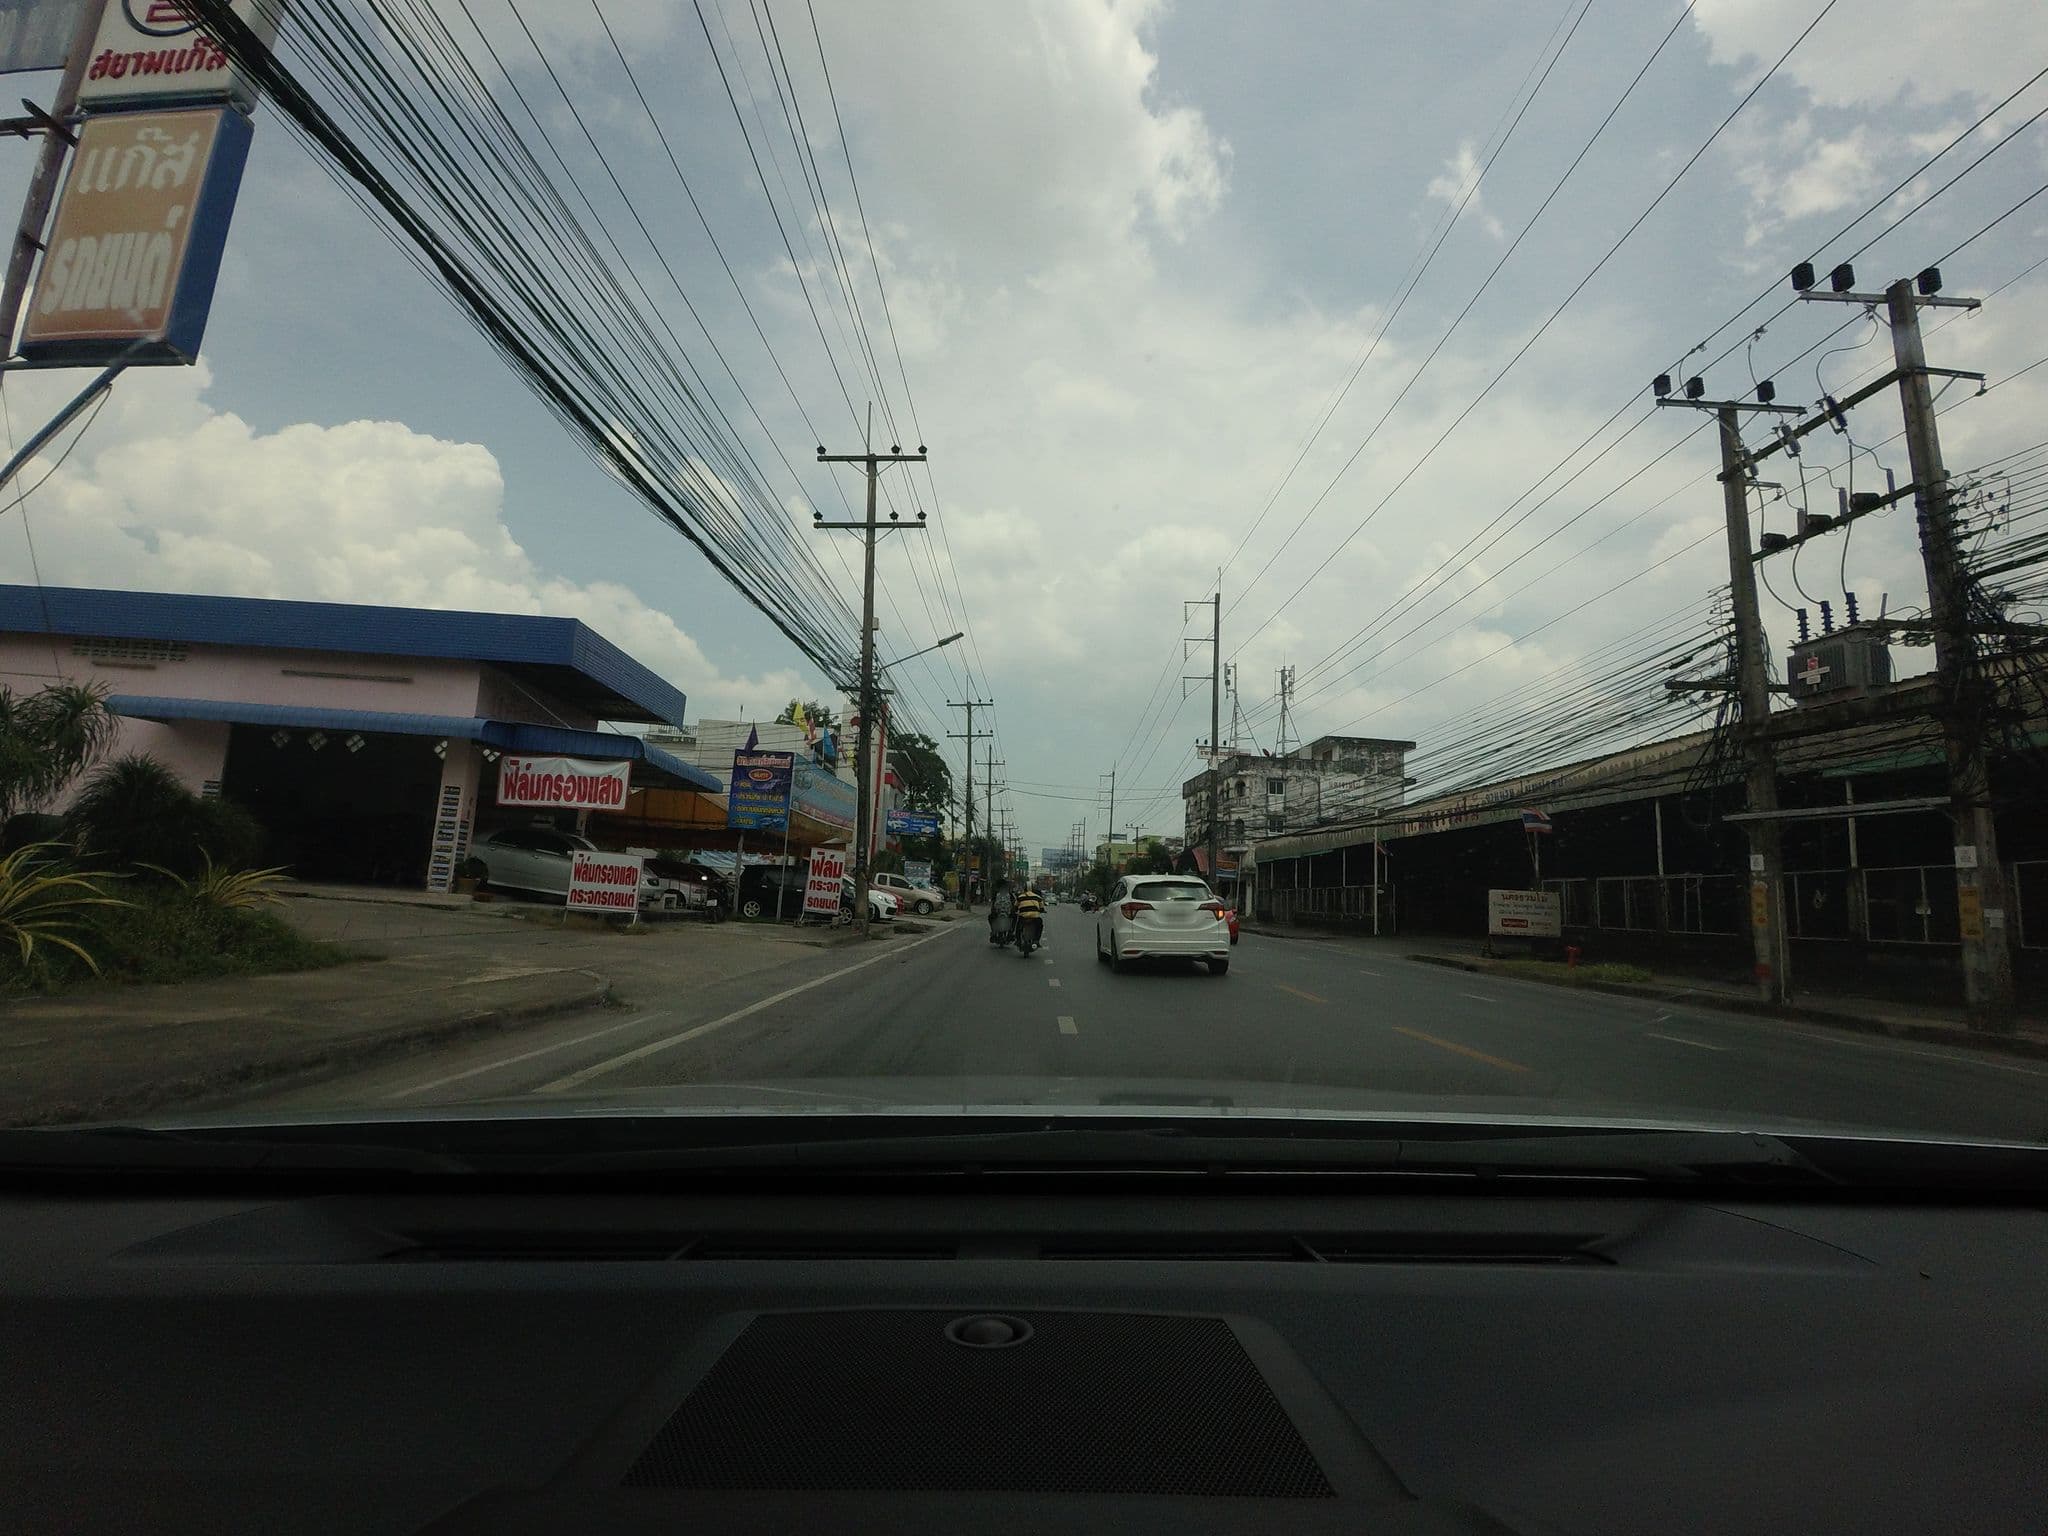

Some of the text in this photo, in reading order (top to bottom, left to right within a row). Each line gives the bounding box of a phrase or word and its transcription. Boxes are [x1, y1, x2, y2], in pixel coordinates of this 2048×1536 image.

[89, 36, 228, 80] สยามแก๊ส
[78, 127, 199, 194] แก๊ส
[41, 205, 184, 315] รถยนต์
[504, 759, 623, 805] ฟิล์มกรองแสง
[574, 853, 638, 886] ฟิล์มกรองแสง
[811, 851, 843, 878] ฟิล์ม
[569, 888, 636, 908] กระจกรถยนต์
[806, 895, 839, 909] รถยนต์
[809, 879, 840, 893] กระจก
